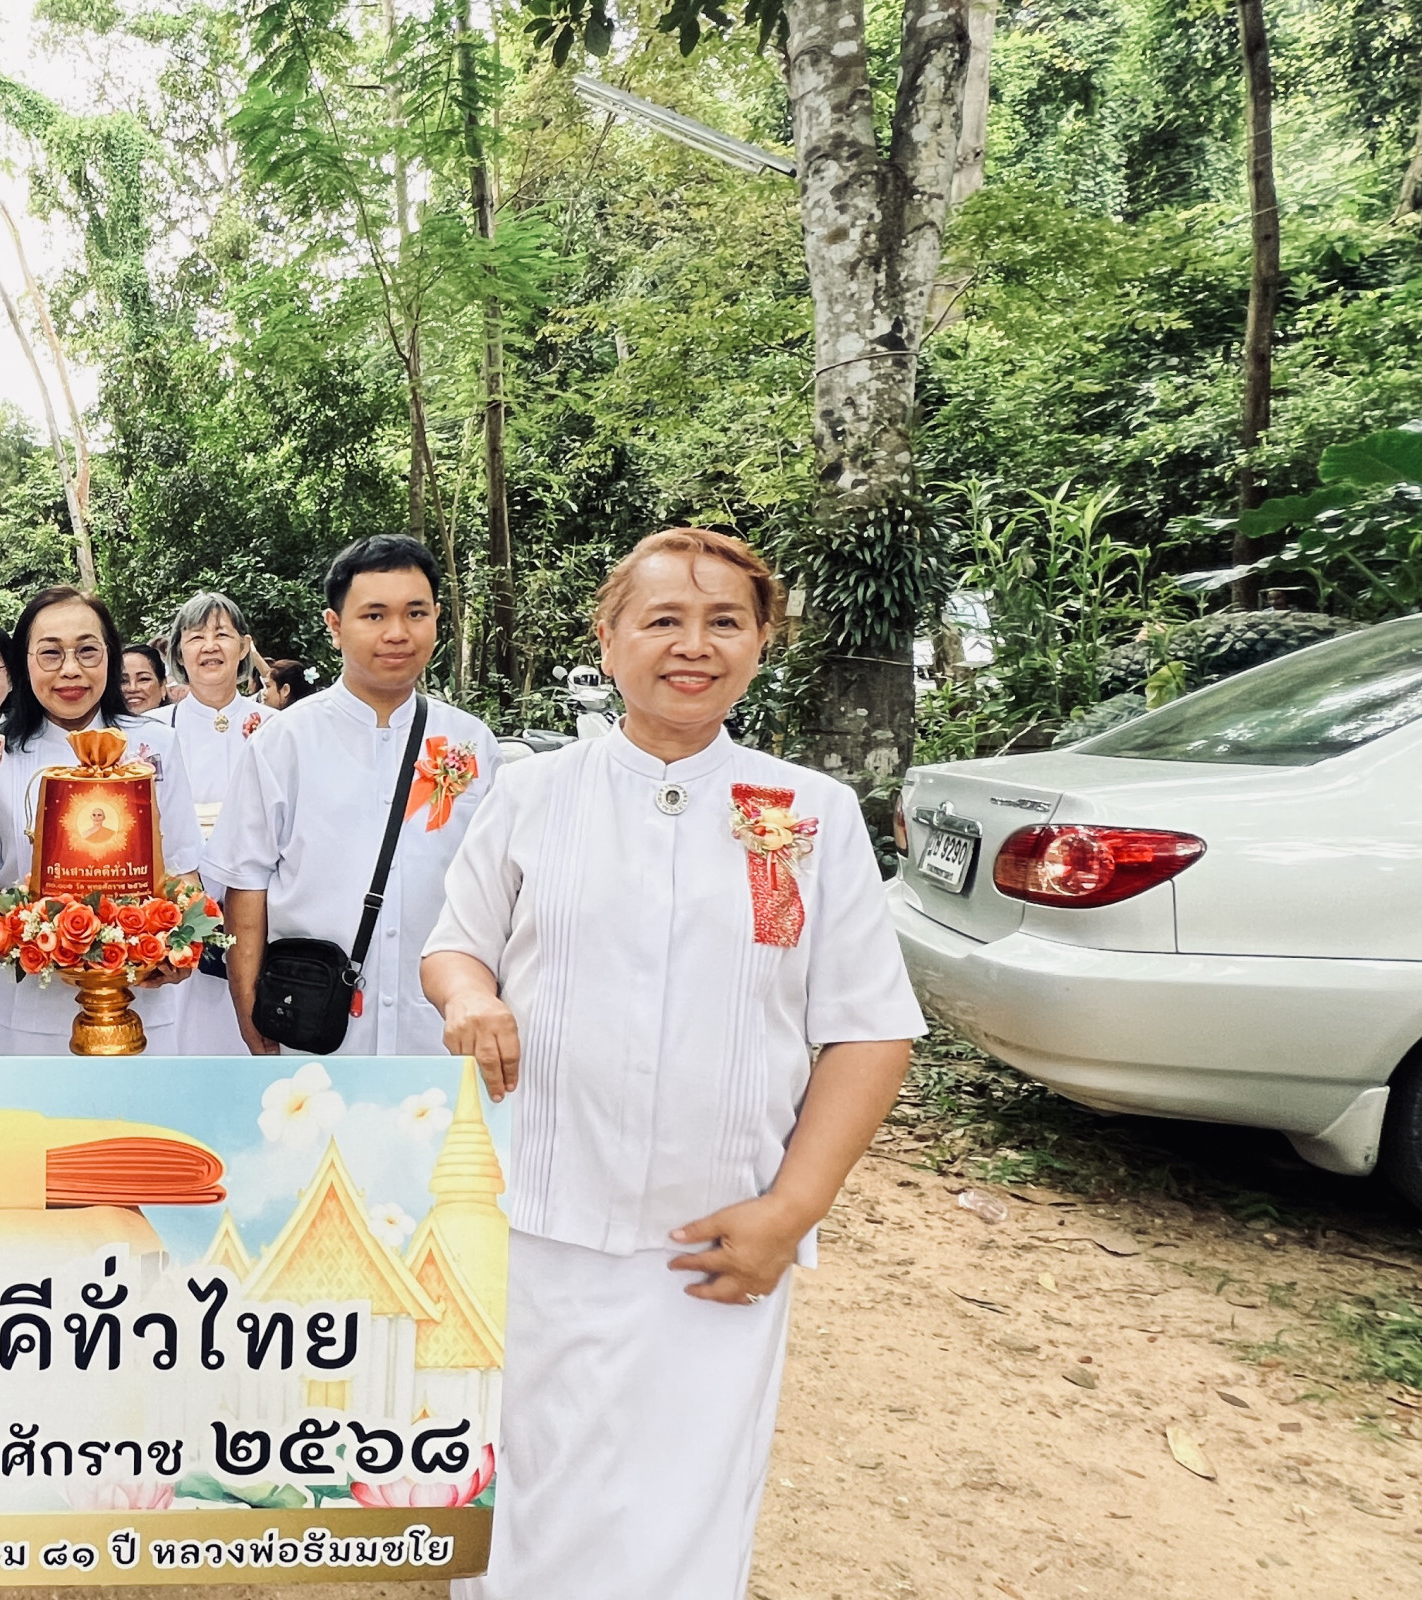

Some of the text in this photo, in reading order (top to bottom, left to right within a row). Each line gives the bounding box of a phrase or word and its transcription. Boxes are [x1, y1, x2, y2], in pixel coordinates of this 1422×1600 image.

[941, 835, 968, 866] 9290
[47, 861, 148, 879] กฐินสามัคคีทั่วไทย
[210, 1418, 472, 1477] ๒๕๖๘
[43, 1543, 96, 1568] ๘๑
[112, 1532, 136, 1566] ปี
[153, 1529, 451, 1566] หลวงพ่อธัมมชโย
